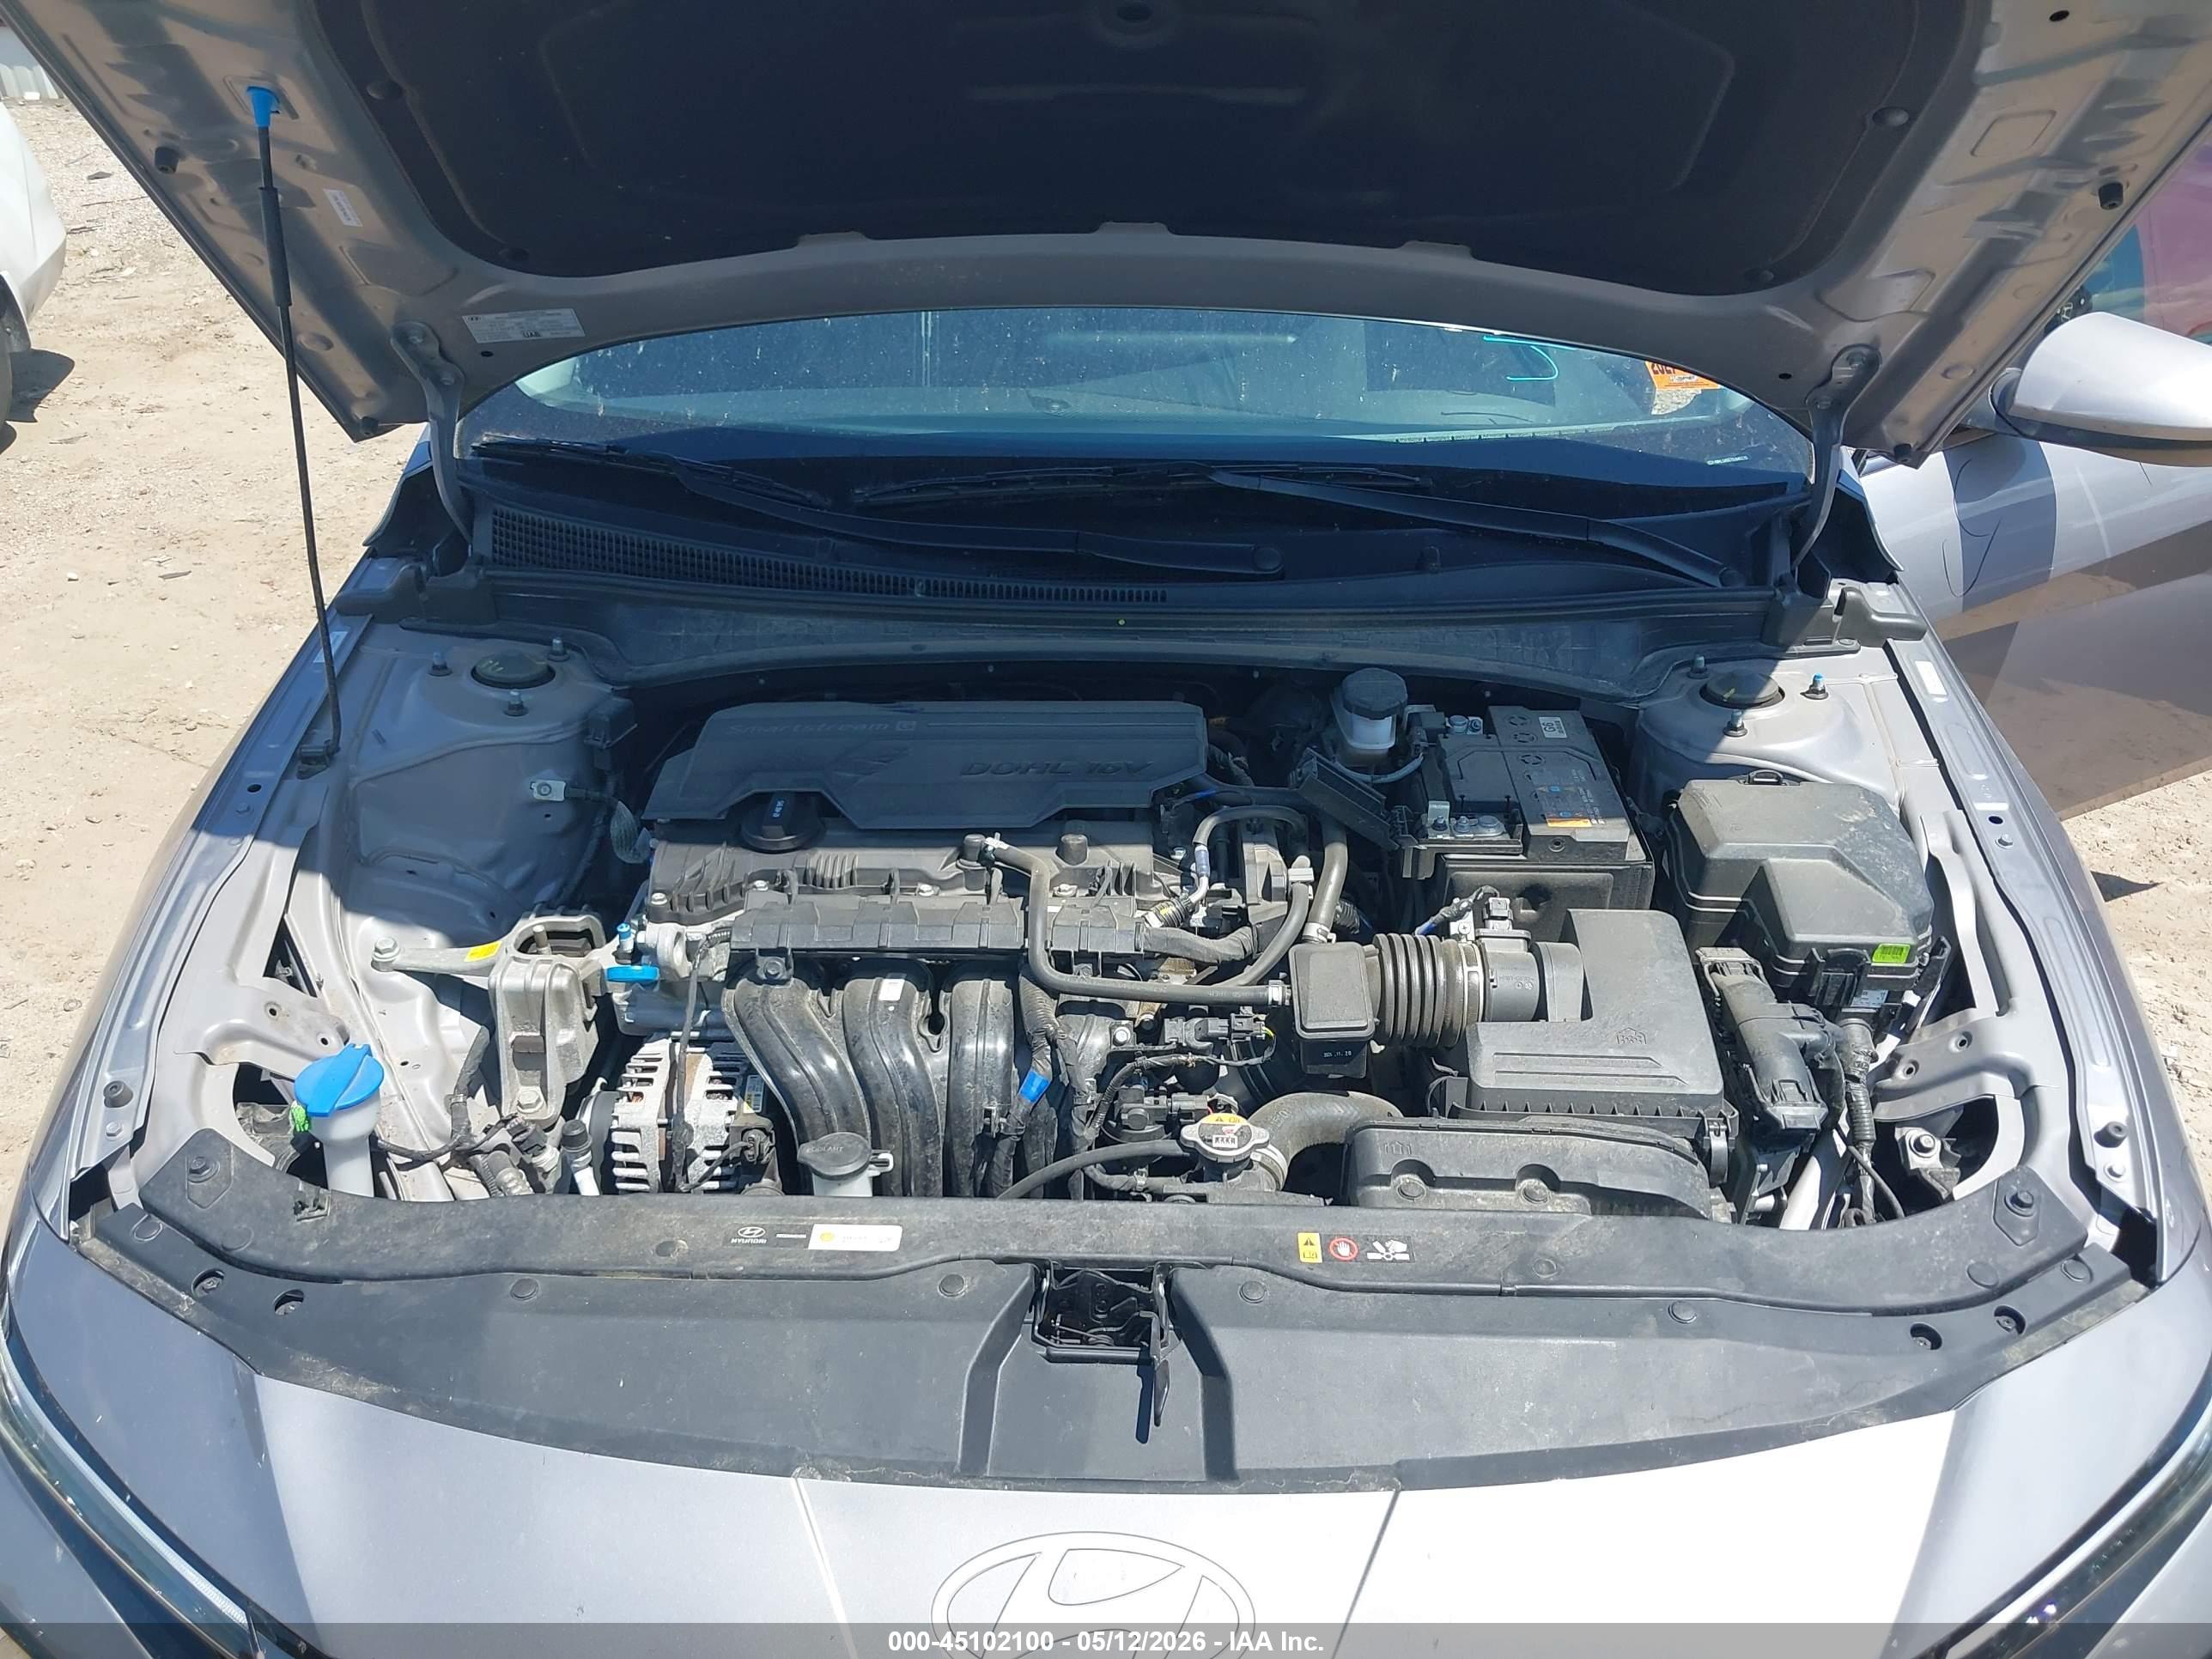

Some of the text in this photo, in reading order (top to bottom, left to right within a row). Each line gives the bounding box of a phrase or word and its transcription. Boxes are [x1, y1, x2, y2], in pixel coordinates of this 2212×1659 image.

[726, 722, 888, 734] Smartstream
[1542, 722, 1555, 732] G6
[960, 761, 1154, 776] DOHC 16V
[805, 1146, 845, 1155] COOLANT
